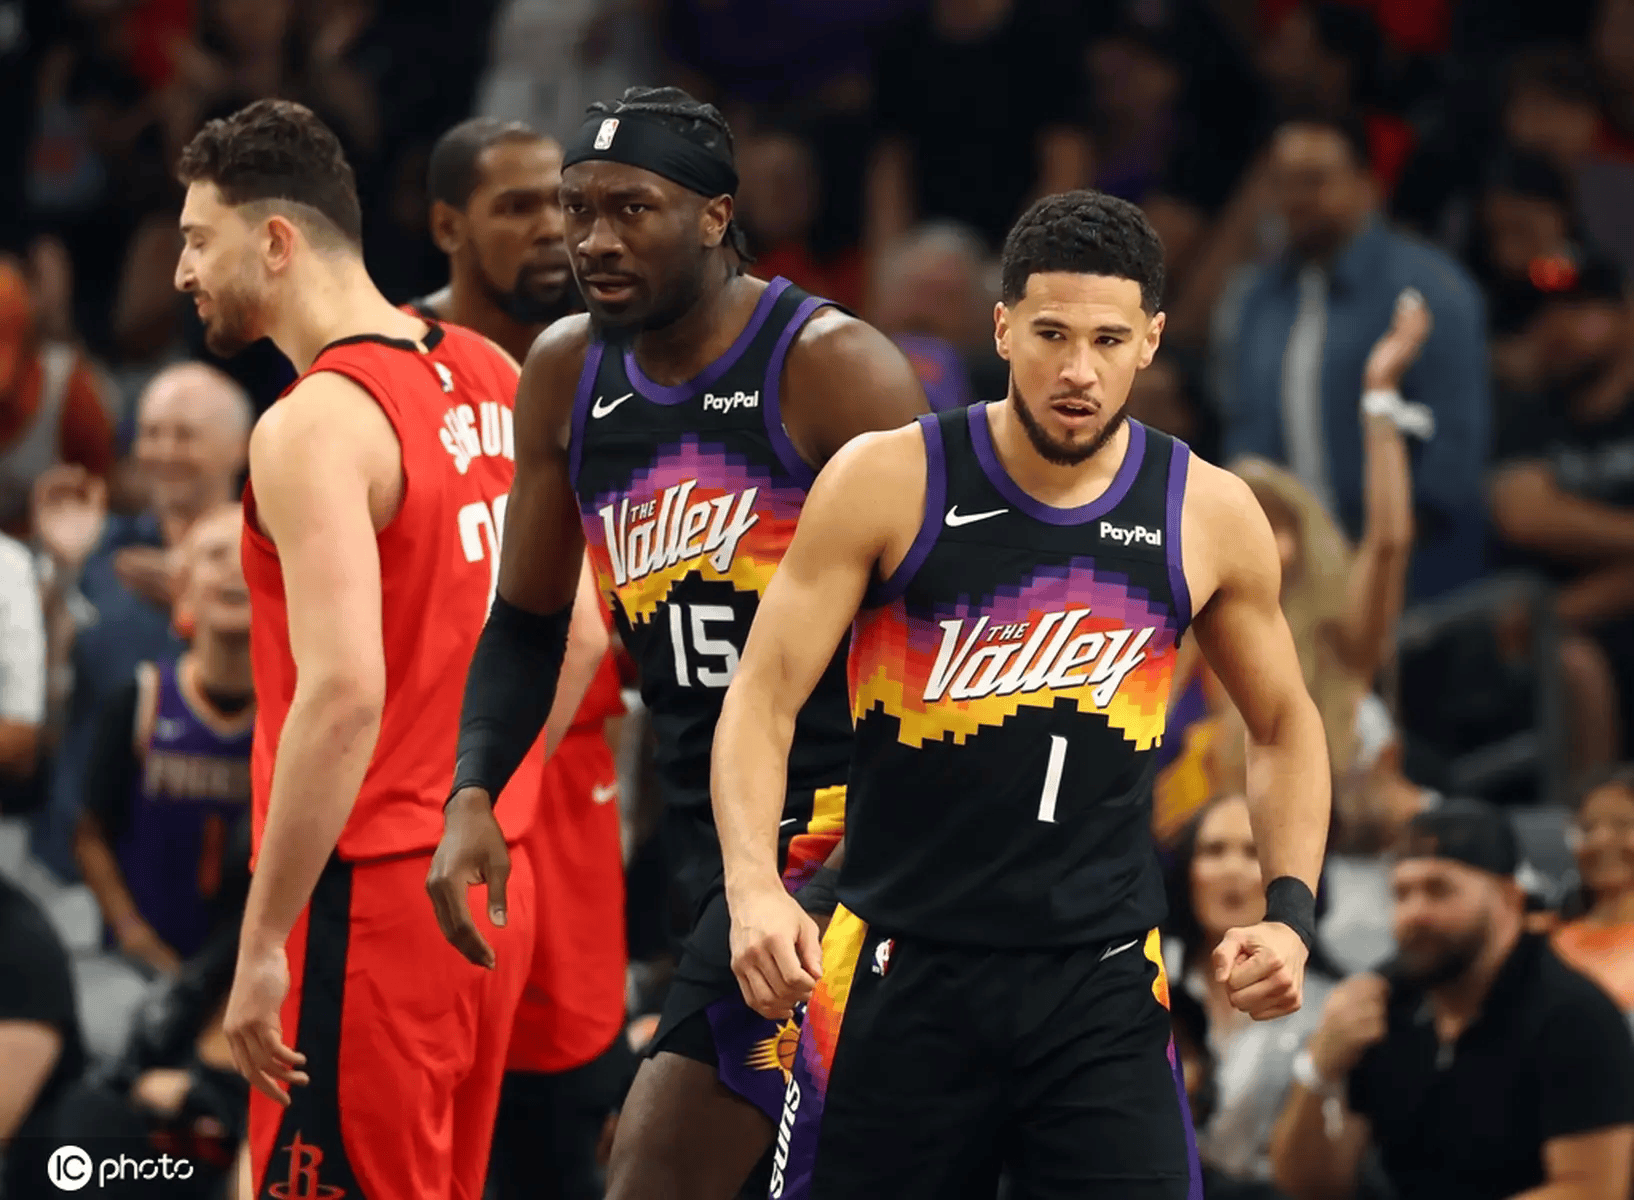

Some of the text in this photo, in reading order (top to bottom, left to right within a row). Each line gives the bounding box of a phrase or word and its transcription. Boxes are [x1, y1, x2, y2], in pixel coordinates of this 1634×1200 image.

[703, 390, 760, 414] PayPal
[598, 478, 760, 588] Valley
[629, 499, 657, 523] THE
[1100, 521, 1162, 547] PayPal
[667, 603, 740, 688] 15
[922, 608, 1156, 709] Valley
[986, 622, 1031, 643] THE
[1037, 734, 1068, 823] 1
